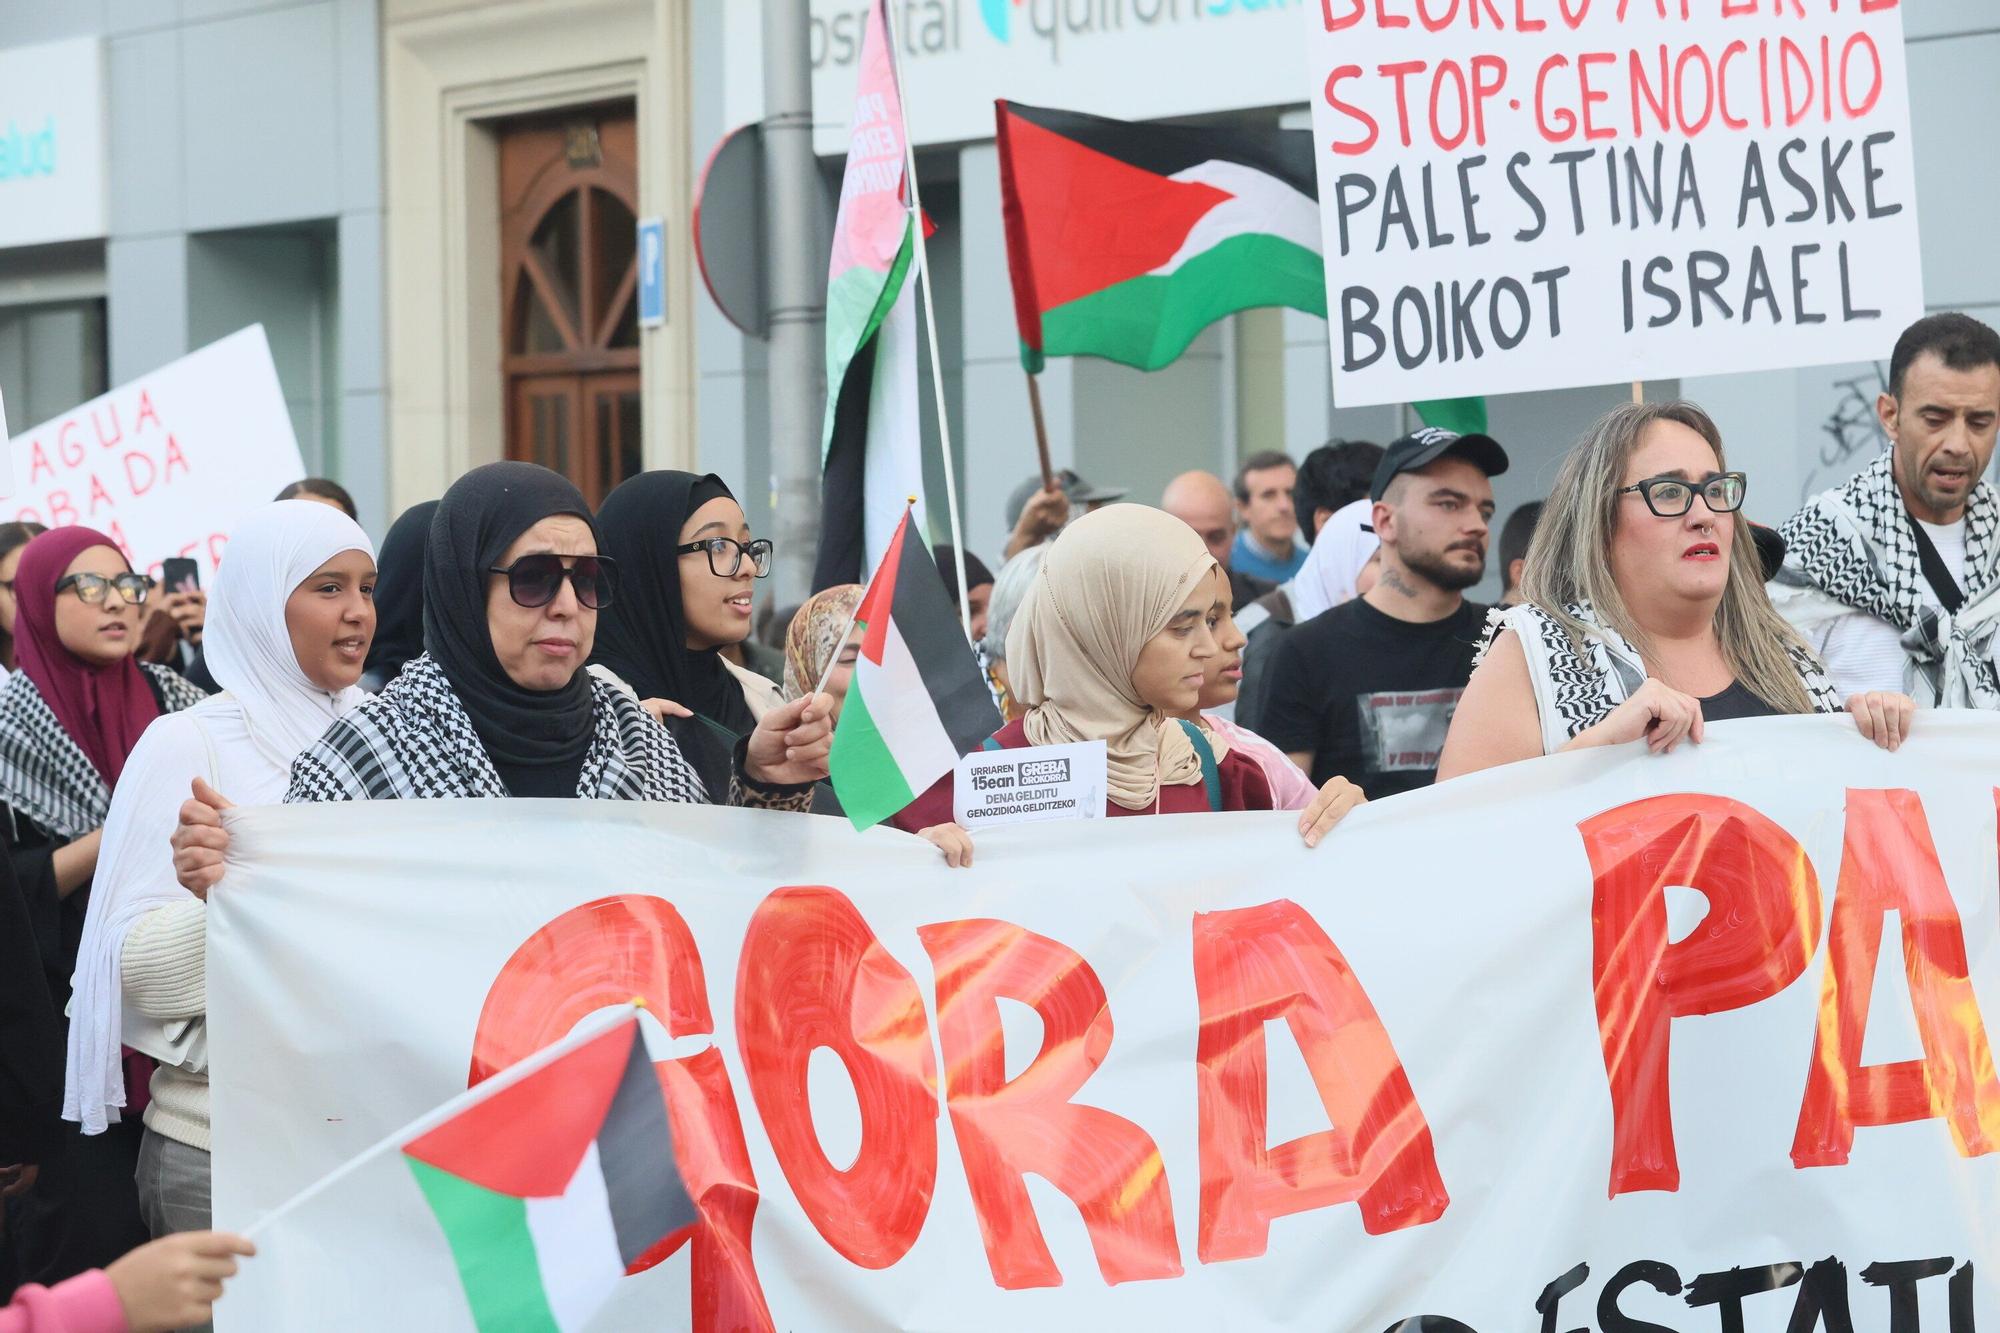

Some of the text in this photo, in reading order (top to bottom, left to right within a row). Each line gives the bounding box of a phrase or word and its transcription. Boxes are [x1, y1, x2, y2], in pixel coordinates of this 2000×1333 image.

[1535, 31, 1882, 143] GENOCIDIO
[1335, 131, 1903, 257] PALESTINA ASKE
[1341, 241, 1882, 372] BOIKOT ISRAEL
[31, 388, 162, 484] AGUA
[970, 764, 1014, 776] URRIAREN
[1021, 760, 1068, 777] GREBA
[971, 776, 1015, 790] 15ean
[1021, 773, 1068, 785] OROKORRA
[985, 788, 1058, 805] DENA GELDITU
[966, 799, 1076, 818] GENOZIDIOA GELDITZEKO!
[467, 785, 2000, 1333] GORA PA
